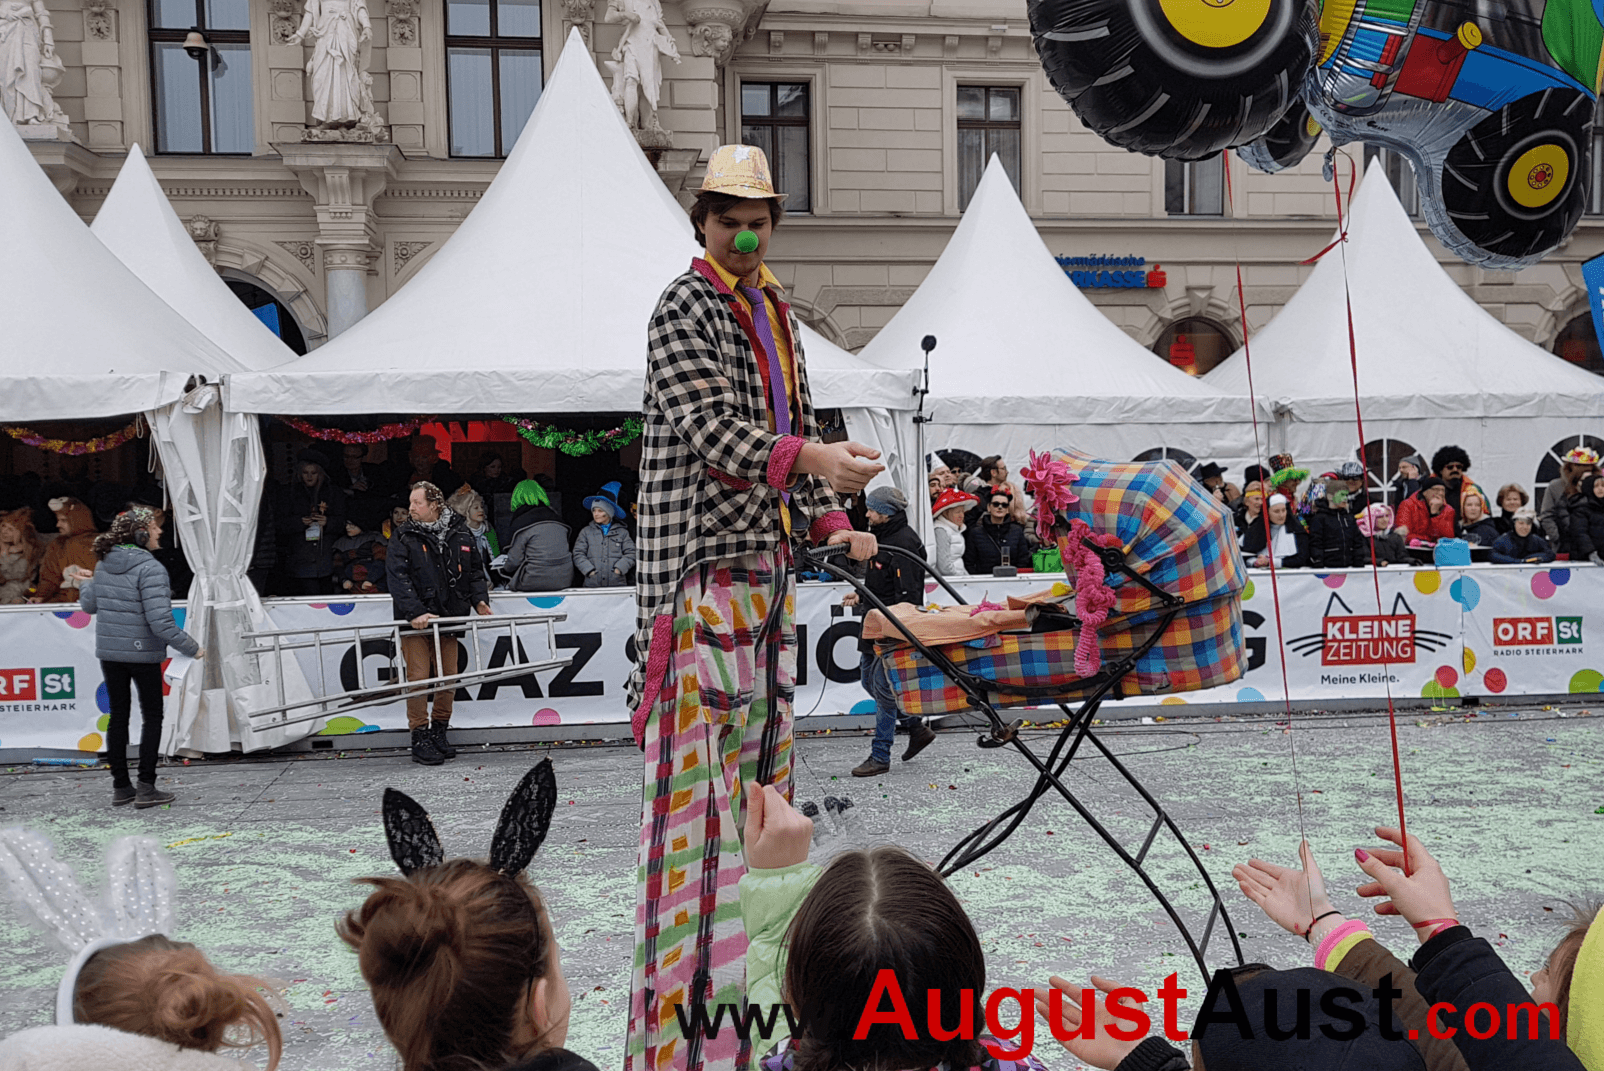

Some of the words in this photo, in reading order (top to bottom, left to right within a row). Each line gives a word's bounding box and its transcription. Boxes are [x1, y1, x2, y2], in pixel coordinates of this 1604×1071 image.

[1327, 619, 1411, 640] KLEINE
[1497, 621, 1549, 641] ORF
[1558, 621, 1580, 639] St
[1326, 639, 1411, 660] ZEITUNG
[1525, 647, 1583, 656] STEIERMARK
[44, 673, 73, 694] St
[1321, 674, 1357, 685] Meine
[1359, 672, 1400, 684] Kleine.
